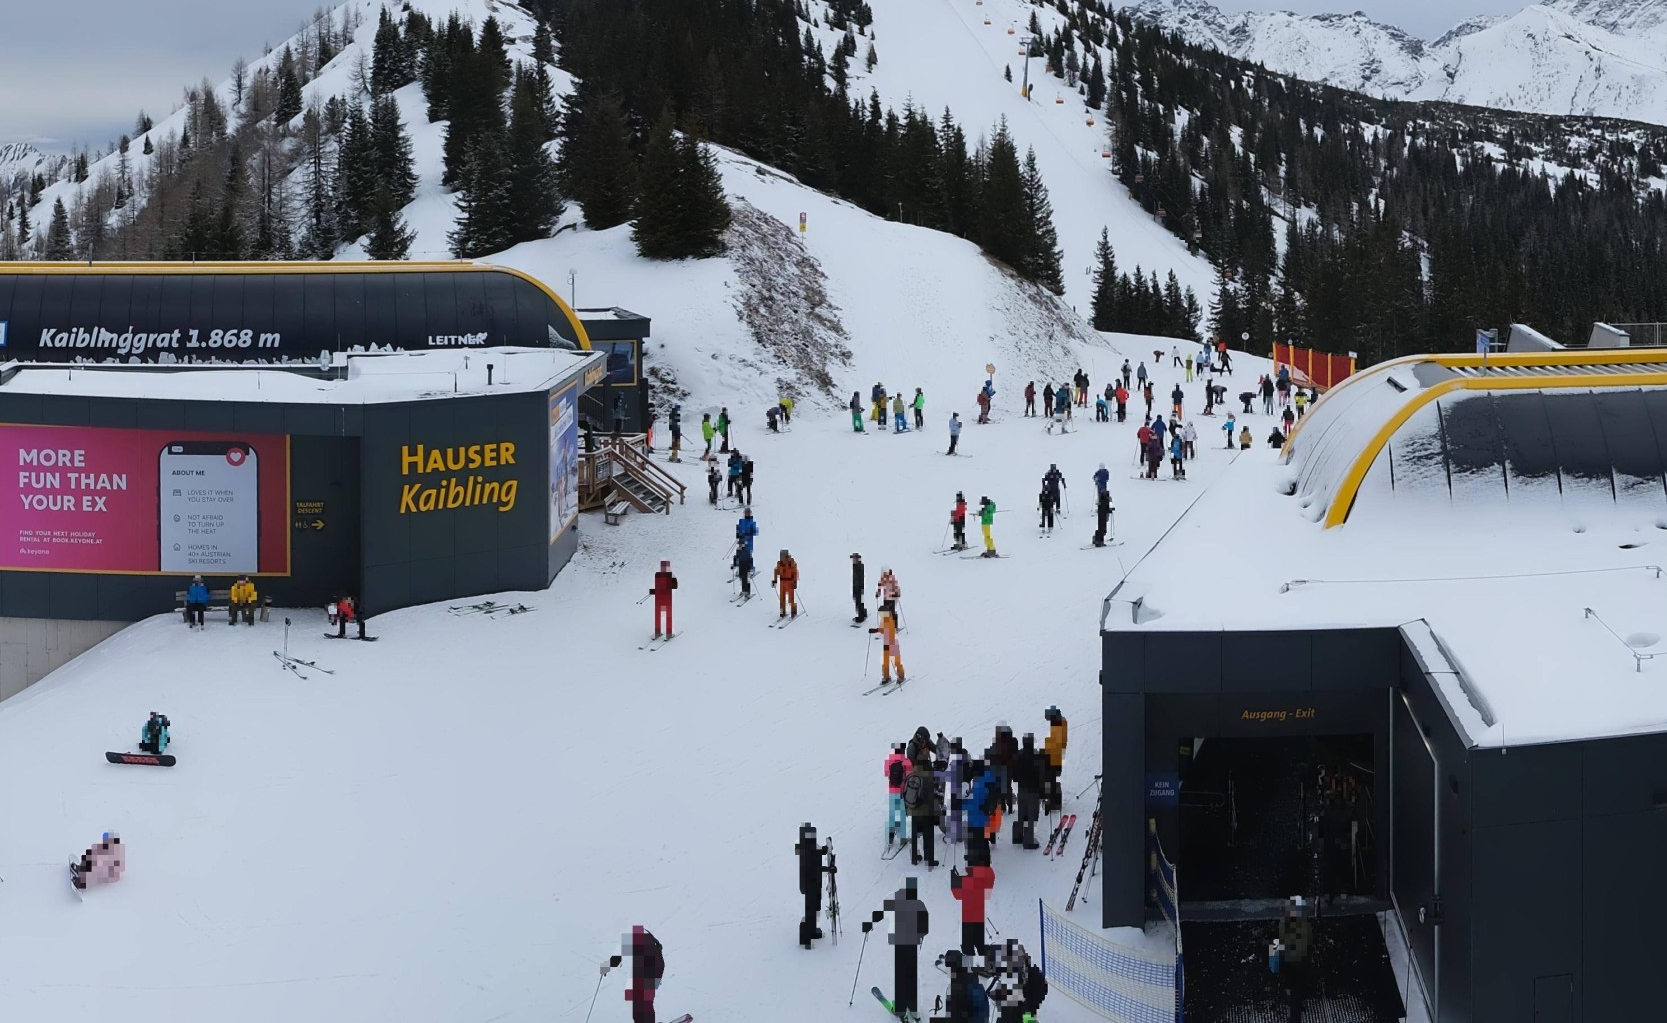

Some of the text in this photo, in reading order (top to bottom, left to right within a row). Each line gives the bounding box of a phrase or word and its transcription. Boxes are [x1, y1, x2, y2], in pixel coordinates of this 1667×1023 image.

[39, 327, 281, 355] Kaiblinggrat 1.868 m
[428, 335, 485, 345] LEITNER
[19, 448, 85, 467] MORE
[19, 471, 127, 490] FUN THAN
[20, 494, 107, 512] YOUR EX
[400, 476, 518, 514] Kaibling
[1241, 709, 1287, 721] Ausgang
[1295, 707, 1316, 718] Exit
[1149, 789, 1175, 797] ZUGANG
